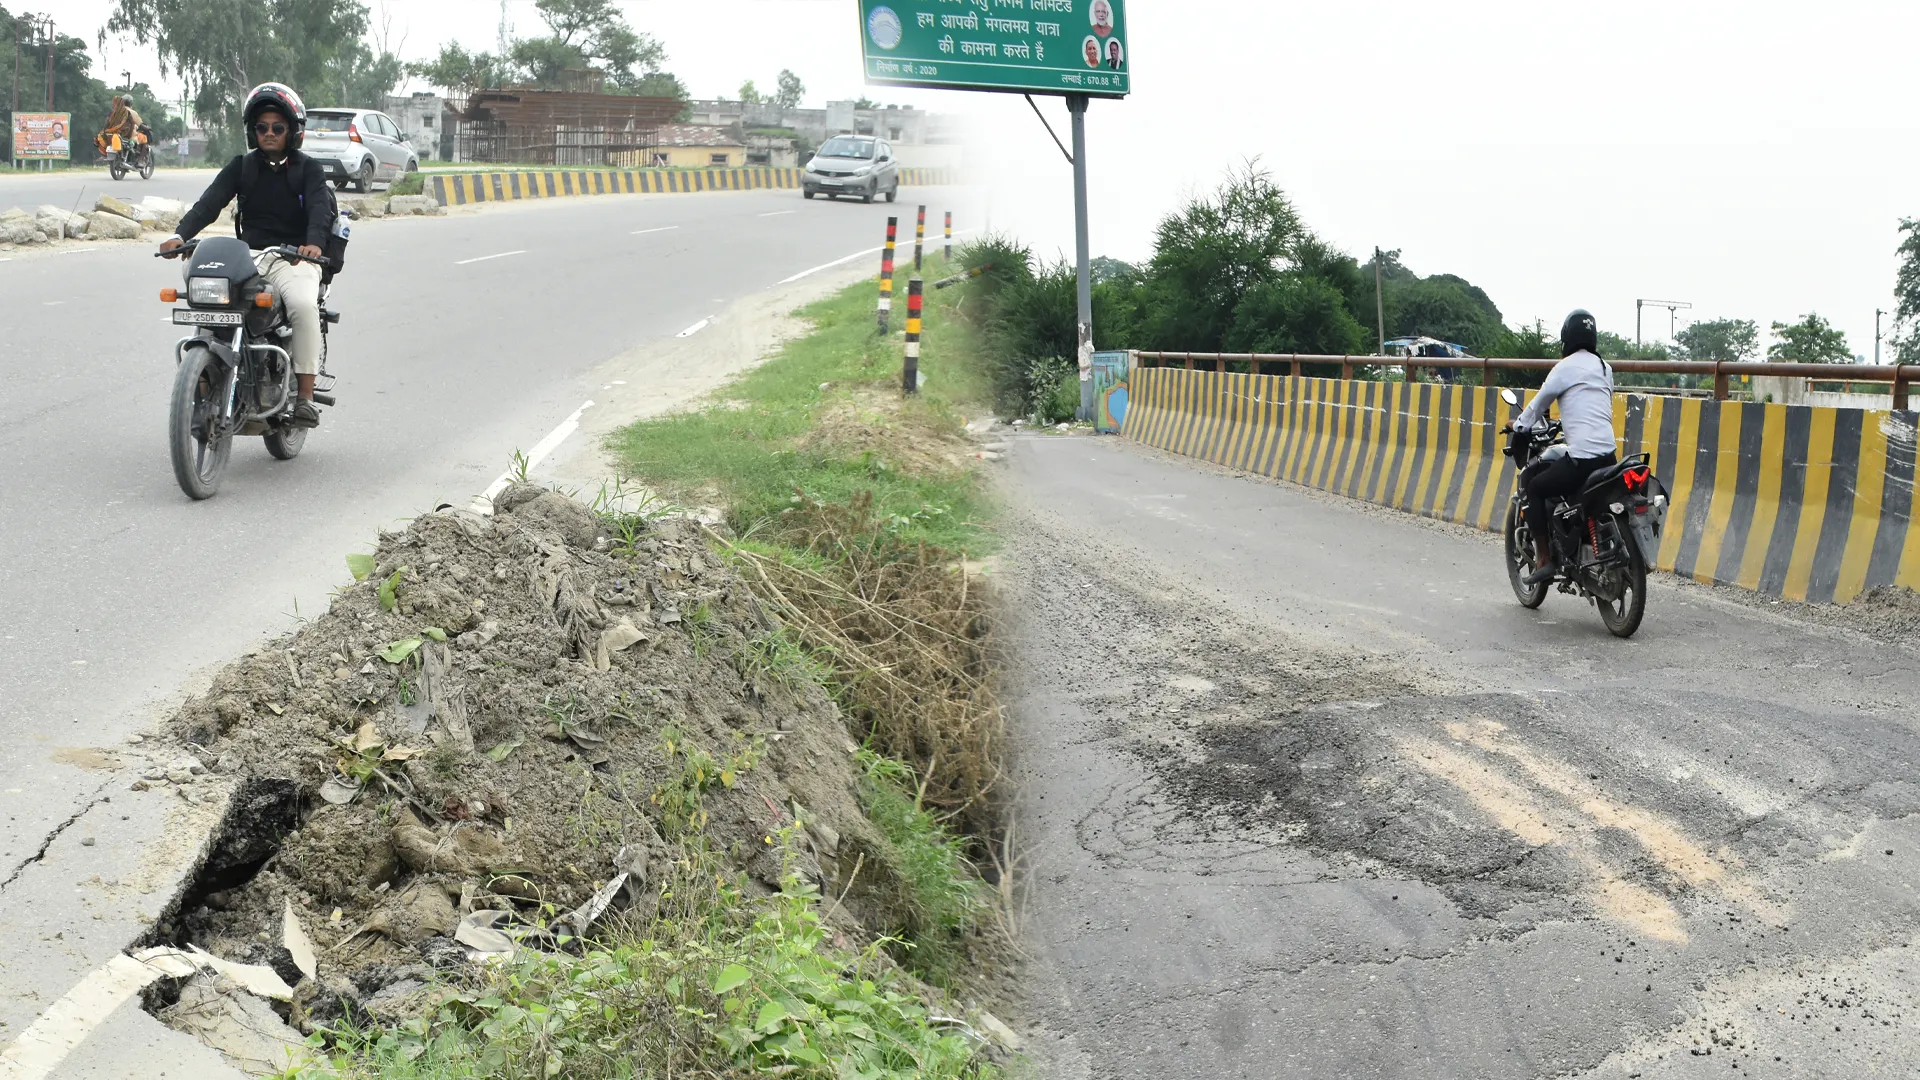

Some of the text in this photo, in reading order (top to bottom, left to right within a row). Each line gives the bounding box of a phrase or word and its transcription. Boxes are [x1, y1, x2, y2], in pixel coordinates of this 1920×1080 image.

[1030, 0, 1073, 13] लिमिटड
[916, 11, 1060, 37] हम आपकी मंगलमय यात्रा
[938, 34, 1044, 61] की कामना करते हैं
[876, 60, 899, 73] निर्माण
[902, 61, 914, 74] वर्ष
[919, 65, 938, 76] 2020
[1061, 72, 1082, 86] लम्बाई
[1087, 76, 1110, 86] 670.88
[182, 312, 191, 321] UP
[219, 314, 240, 323] 2331
